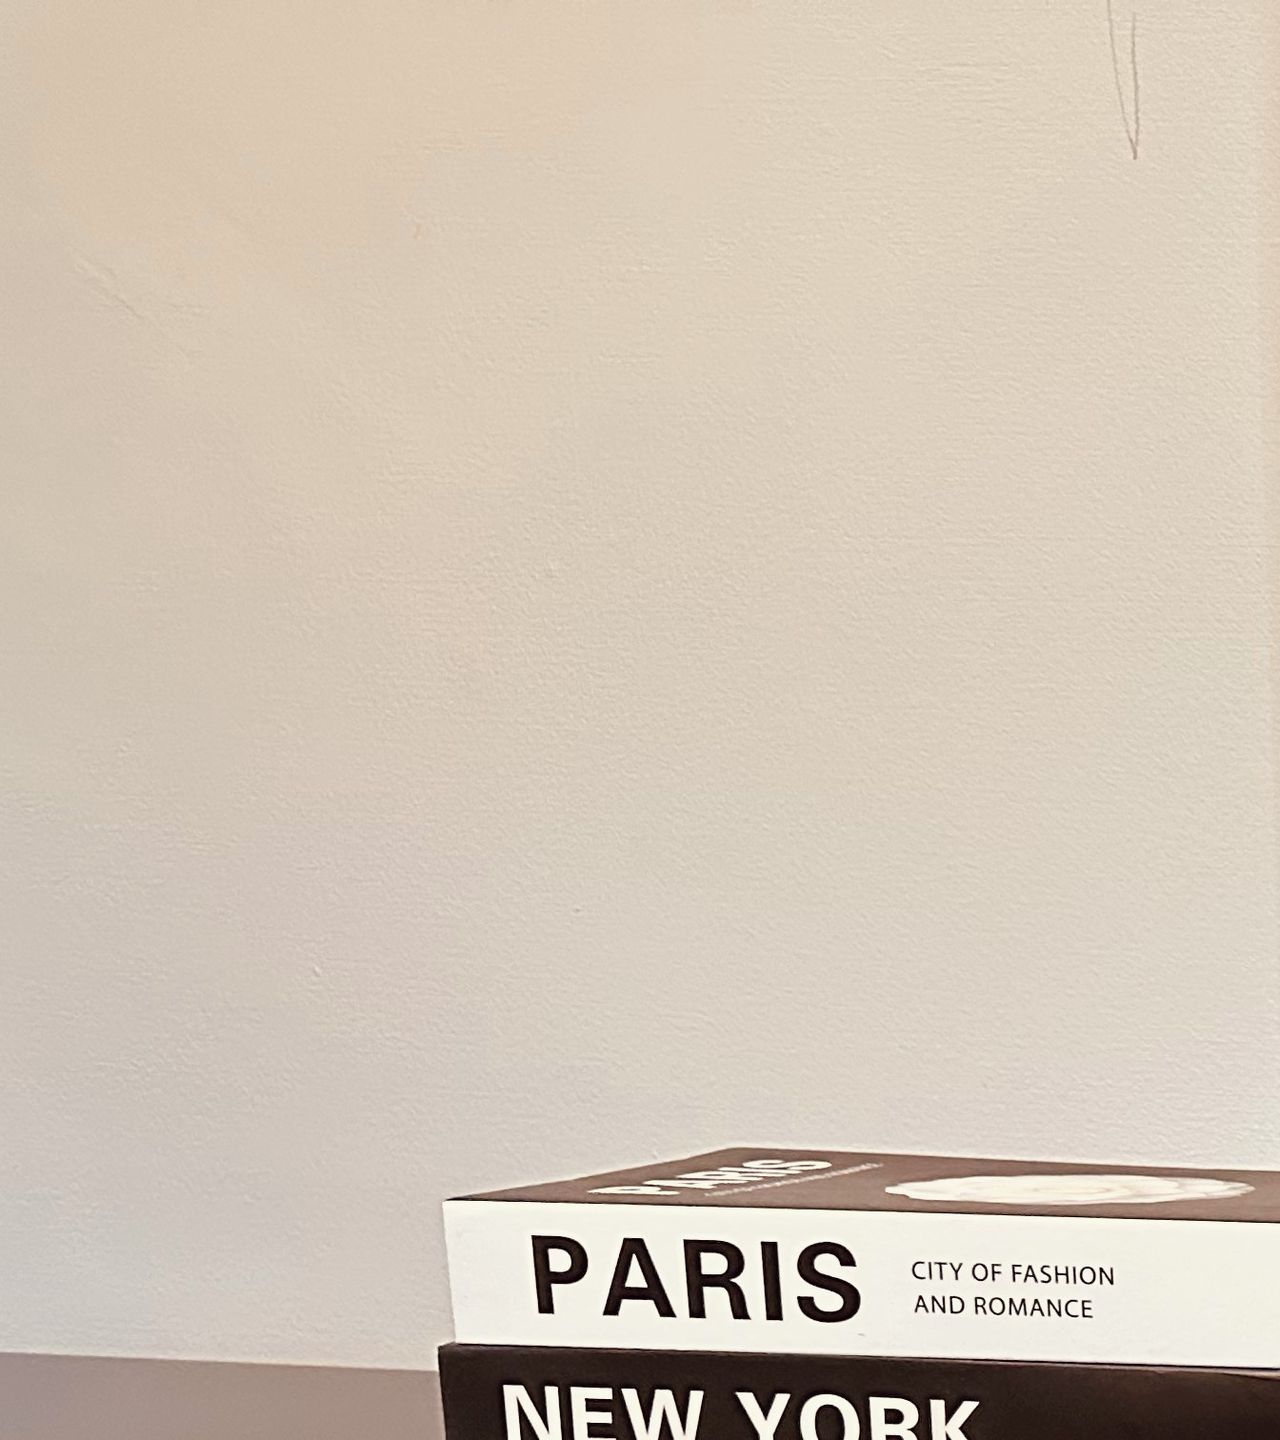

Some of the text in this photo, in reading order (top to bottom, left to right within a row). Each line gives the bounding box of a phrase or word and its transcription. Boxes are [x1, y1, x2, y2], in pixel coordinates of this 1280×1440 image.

[587, 1159, 832, 1195] PARIS
[531, 1234, 861, 1324] PARIS
[911, 1261, 1115, 1286] CITY OF FASHION
[914, 1294, 1093, 1319] AND ROMANCE
